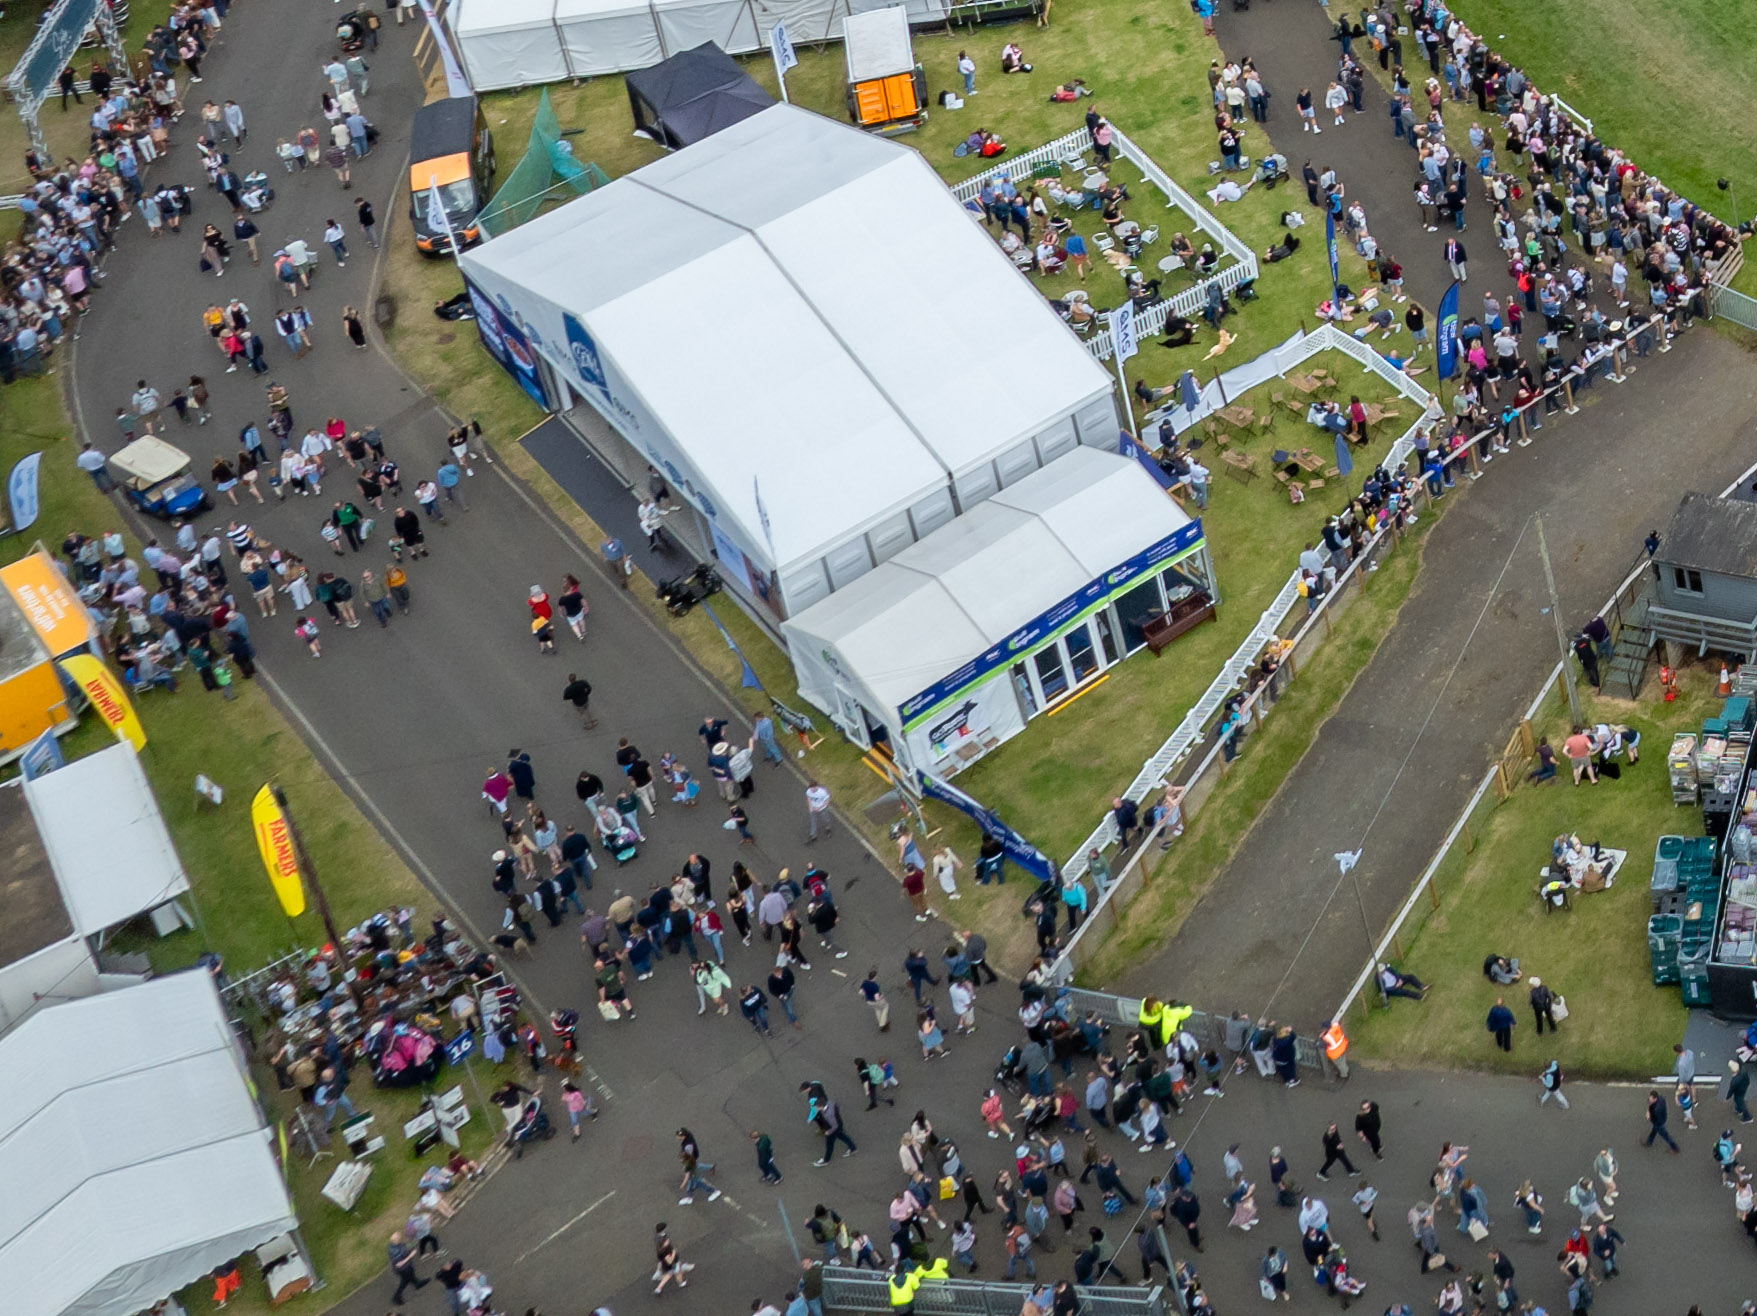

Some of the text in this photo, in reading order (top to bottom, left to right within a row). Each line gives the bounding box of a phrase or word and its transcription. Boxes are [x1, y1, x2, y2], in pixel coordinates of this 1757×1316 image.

[1119, 310, 1132, 354] QMS
[269, 819, 297, 878] FARMERS
[450, 1038, 472, 1059] 16
